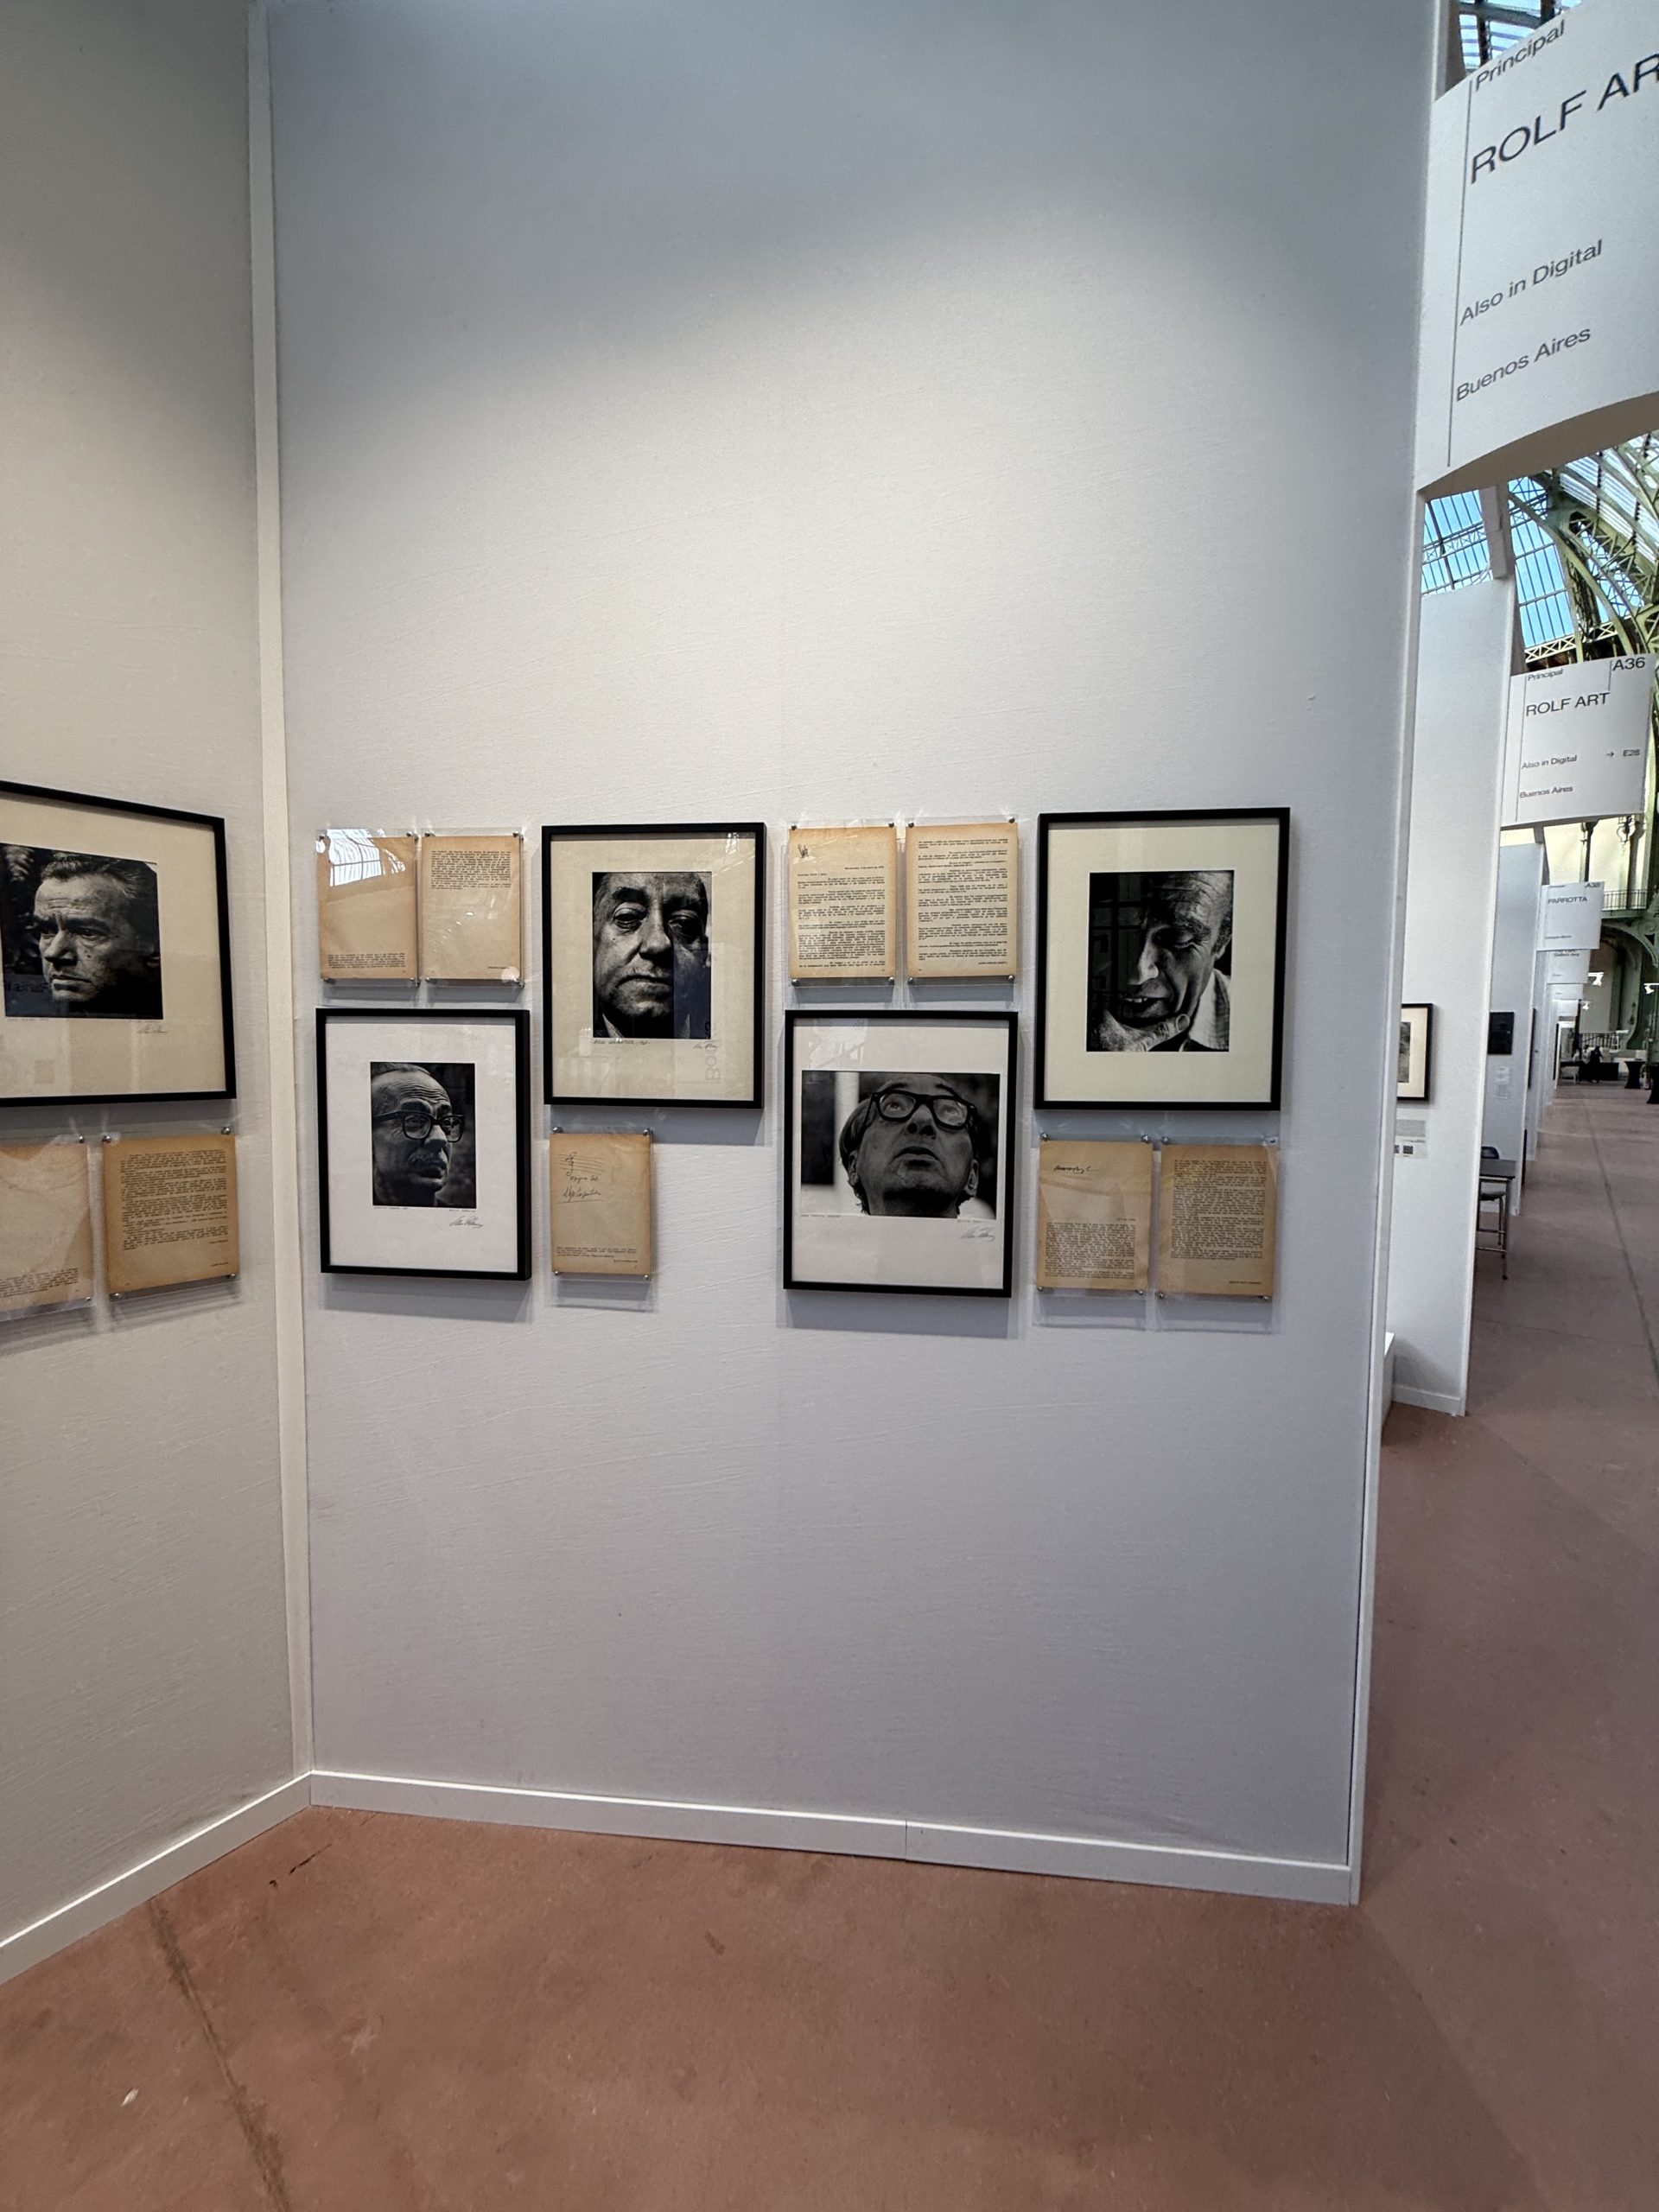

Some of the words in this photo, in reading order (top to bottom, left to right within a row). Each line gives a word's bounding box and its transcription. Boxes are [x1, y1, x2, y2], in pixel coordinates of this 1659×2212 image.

[1476, 19, 1565, 91] Principal
[1471, 89, 1587, 185] ROLF
[1459, 292, 1503, 327] Also
[1508, 279, 1527, 298] in
[1532, 238, 1603, 286] Digital
[1456, 354, 1529, 402] Buenos
[1534, 327, 1592, 362] Aires
[1528, 668, 1563, 681] Principal
[1612, 657, 1646, 671] A36
[1526, 697, 1572, 716] ROLF
[1574, 692, 1611, 708] ART
[1550, 755, 1578, 765] Digital
[1519, 789, 1550, 798] Buenos
[1552, 785, 1573, 794] Aires
